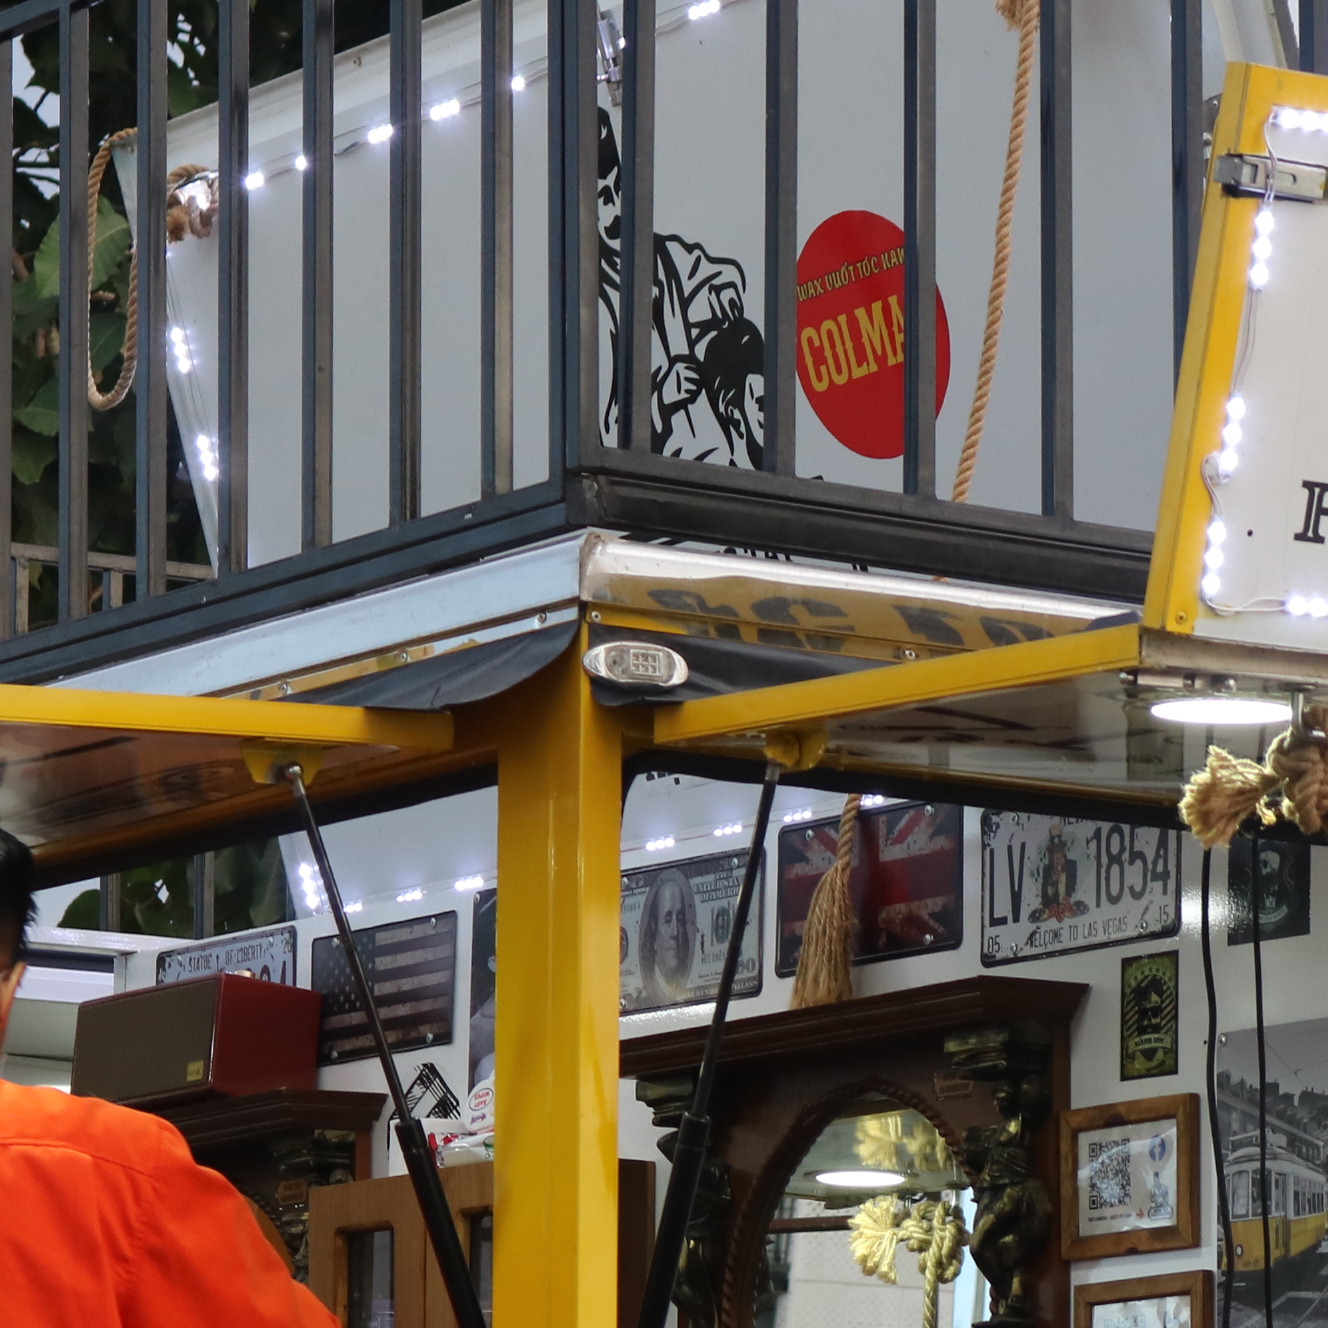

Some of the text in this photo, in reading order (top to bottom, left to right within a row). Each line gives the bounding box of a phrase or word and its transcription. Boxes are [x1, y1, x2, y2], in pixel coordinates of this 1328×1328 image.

[800, 295, 904, 393] COLMA
[1085, 822, 1171, 909] 1854
[1068, 925, 1079, 940] TO
[1082, 922, 1098, 940] LAS
